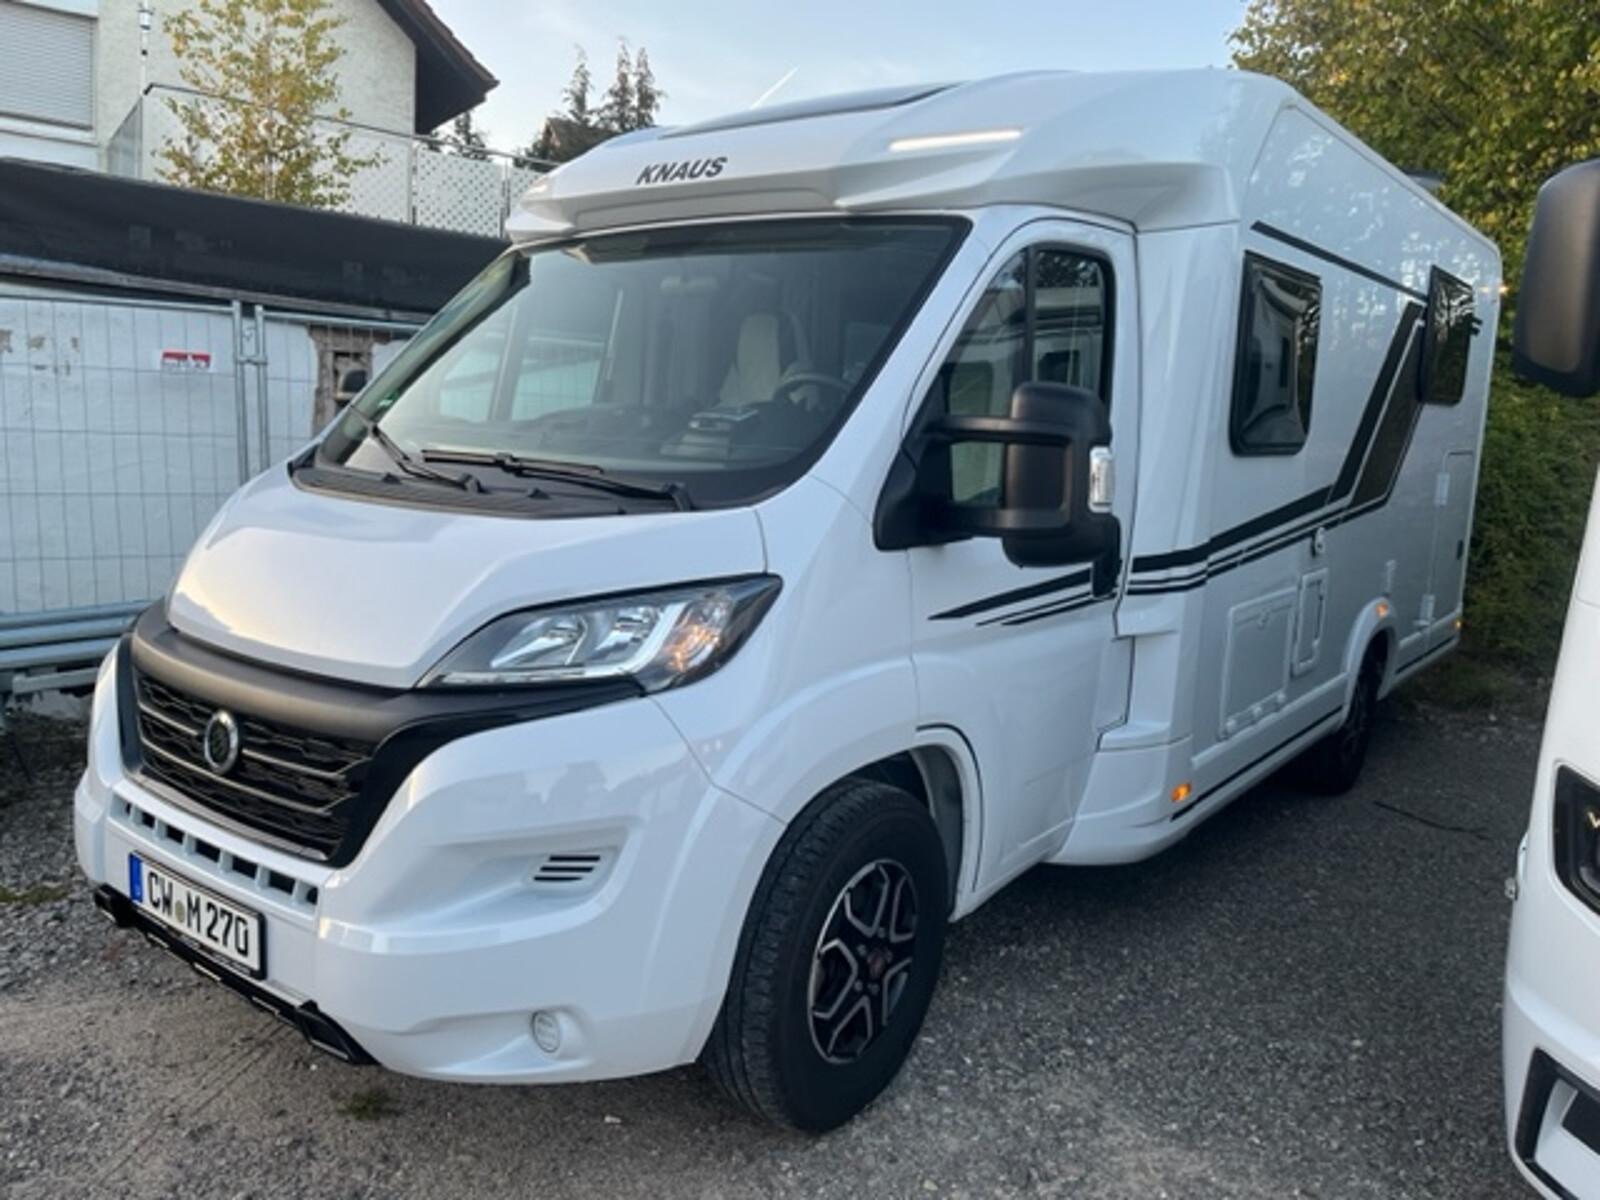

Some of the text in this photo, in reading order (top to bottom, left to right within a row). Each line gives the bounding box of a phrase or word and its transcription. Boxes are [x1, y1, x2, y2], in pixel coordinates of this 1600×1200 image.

[635, 157, 728, 185] KNAUS
[148, 871, 173, 917] CW
[186, 890, 202, 933] M
[206, 901, 249, 958] 270
